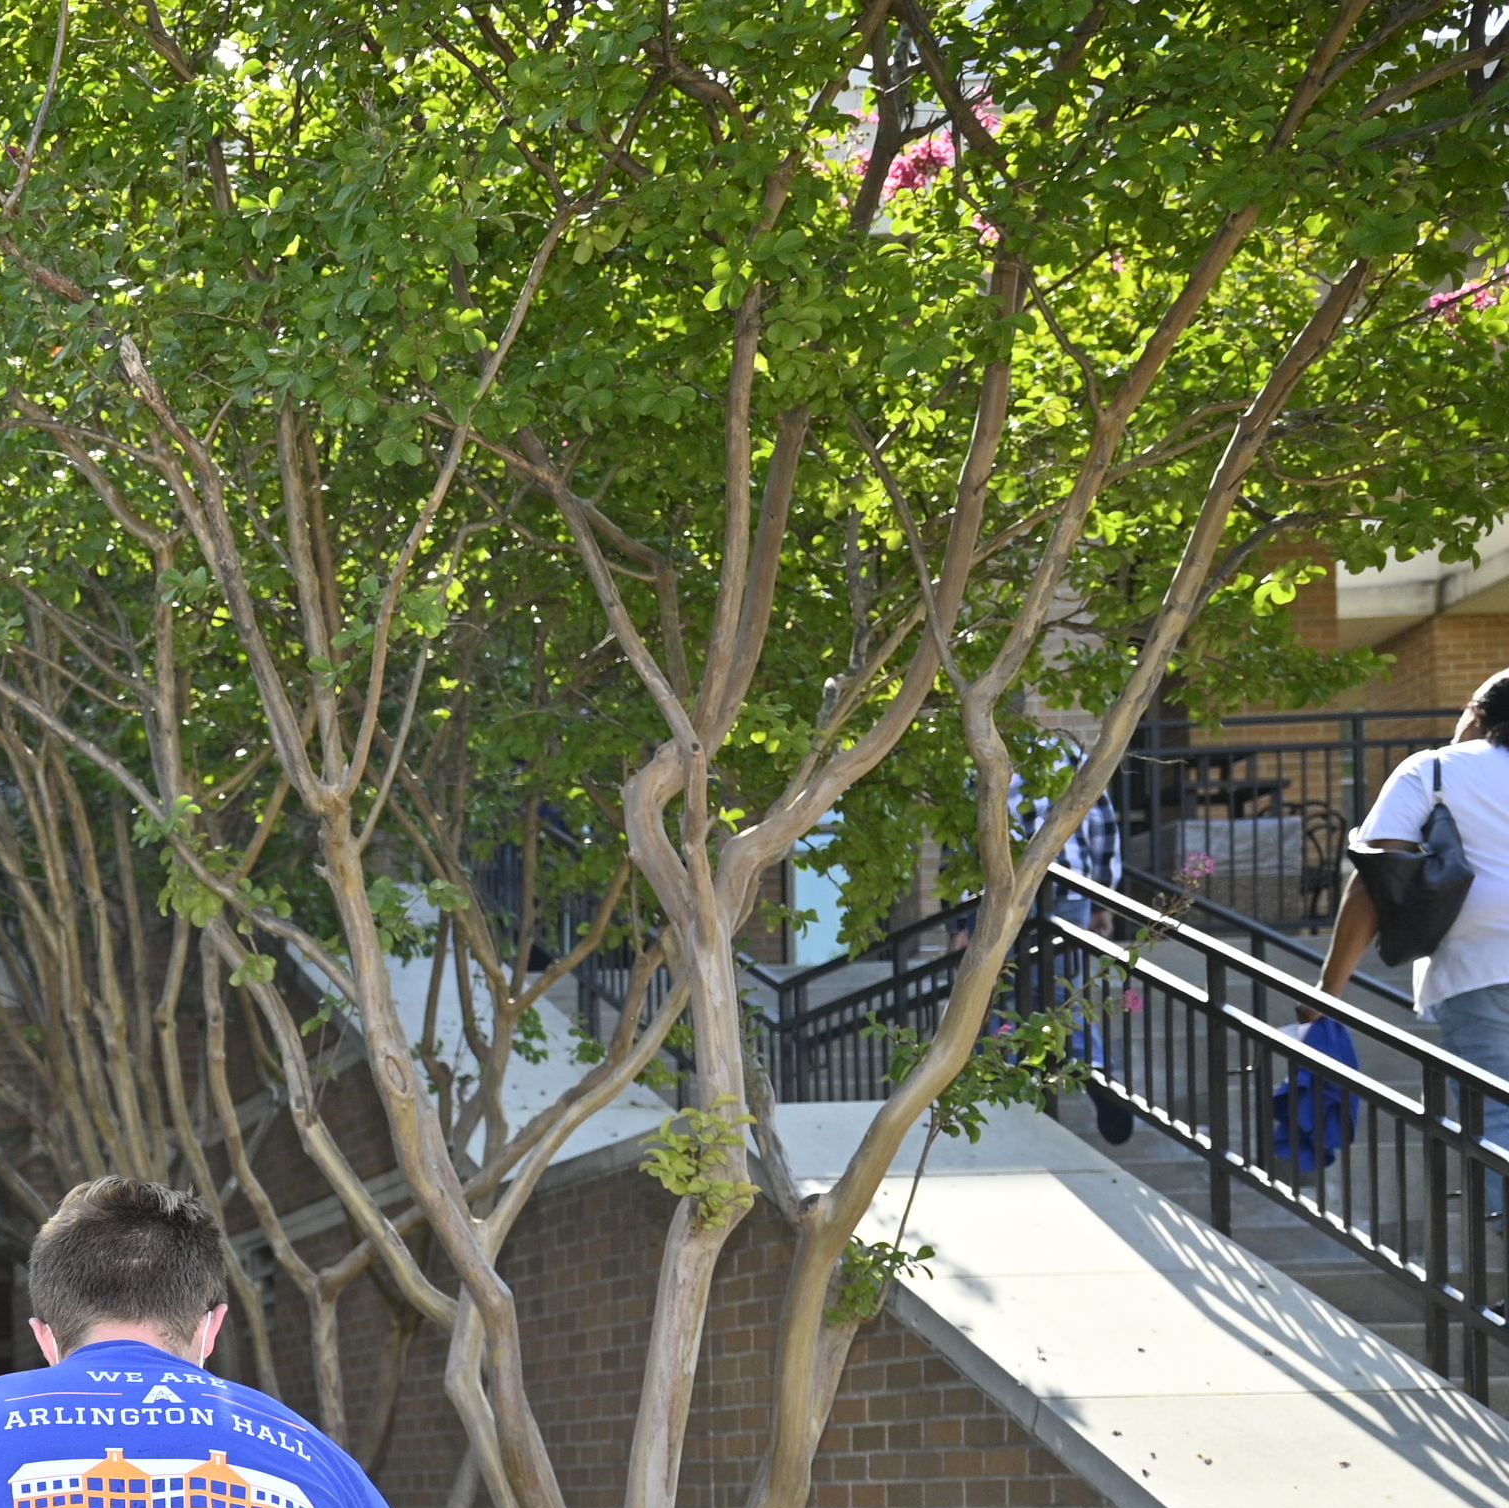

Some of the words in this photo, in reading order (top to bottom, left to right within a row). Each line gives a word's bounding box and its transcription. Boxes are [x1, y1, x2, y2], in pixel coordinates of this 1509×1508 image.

[86, 1371, 144, 1384] WE
[160, 1371, 227, 1390] ARE
[3, 1407, 214, 1430] ARLINGTON
[231, 1414, 312, 1462] HALL
